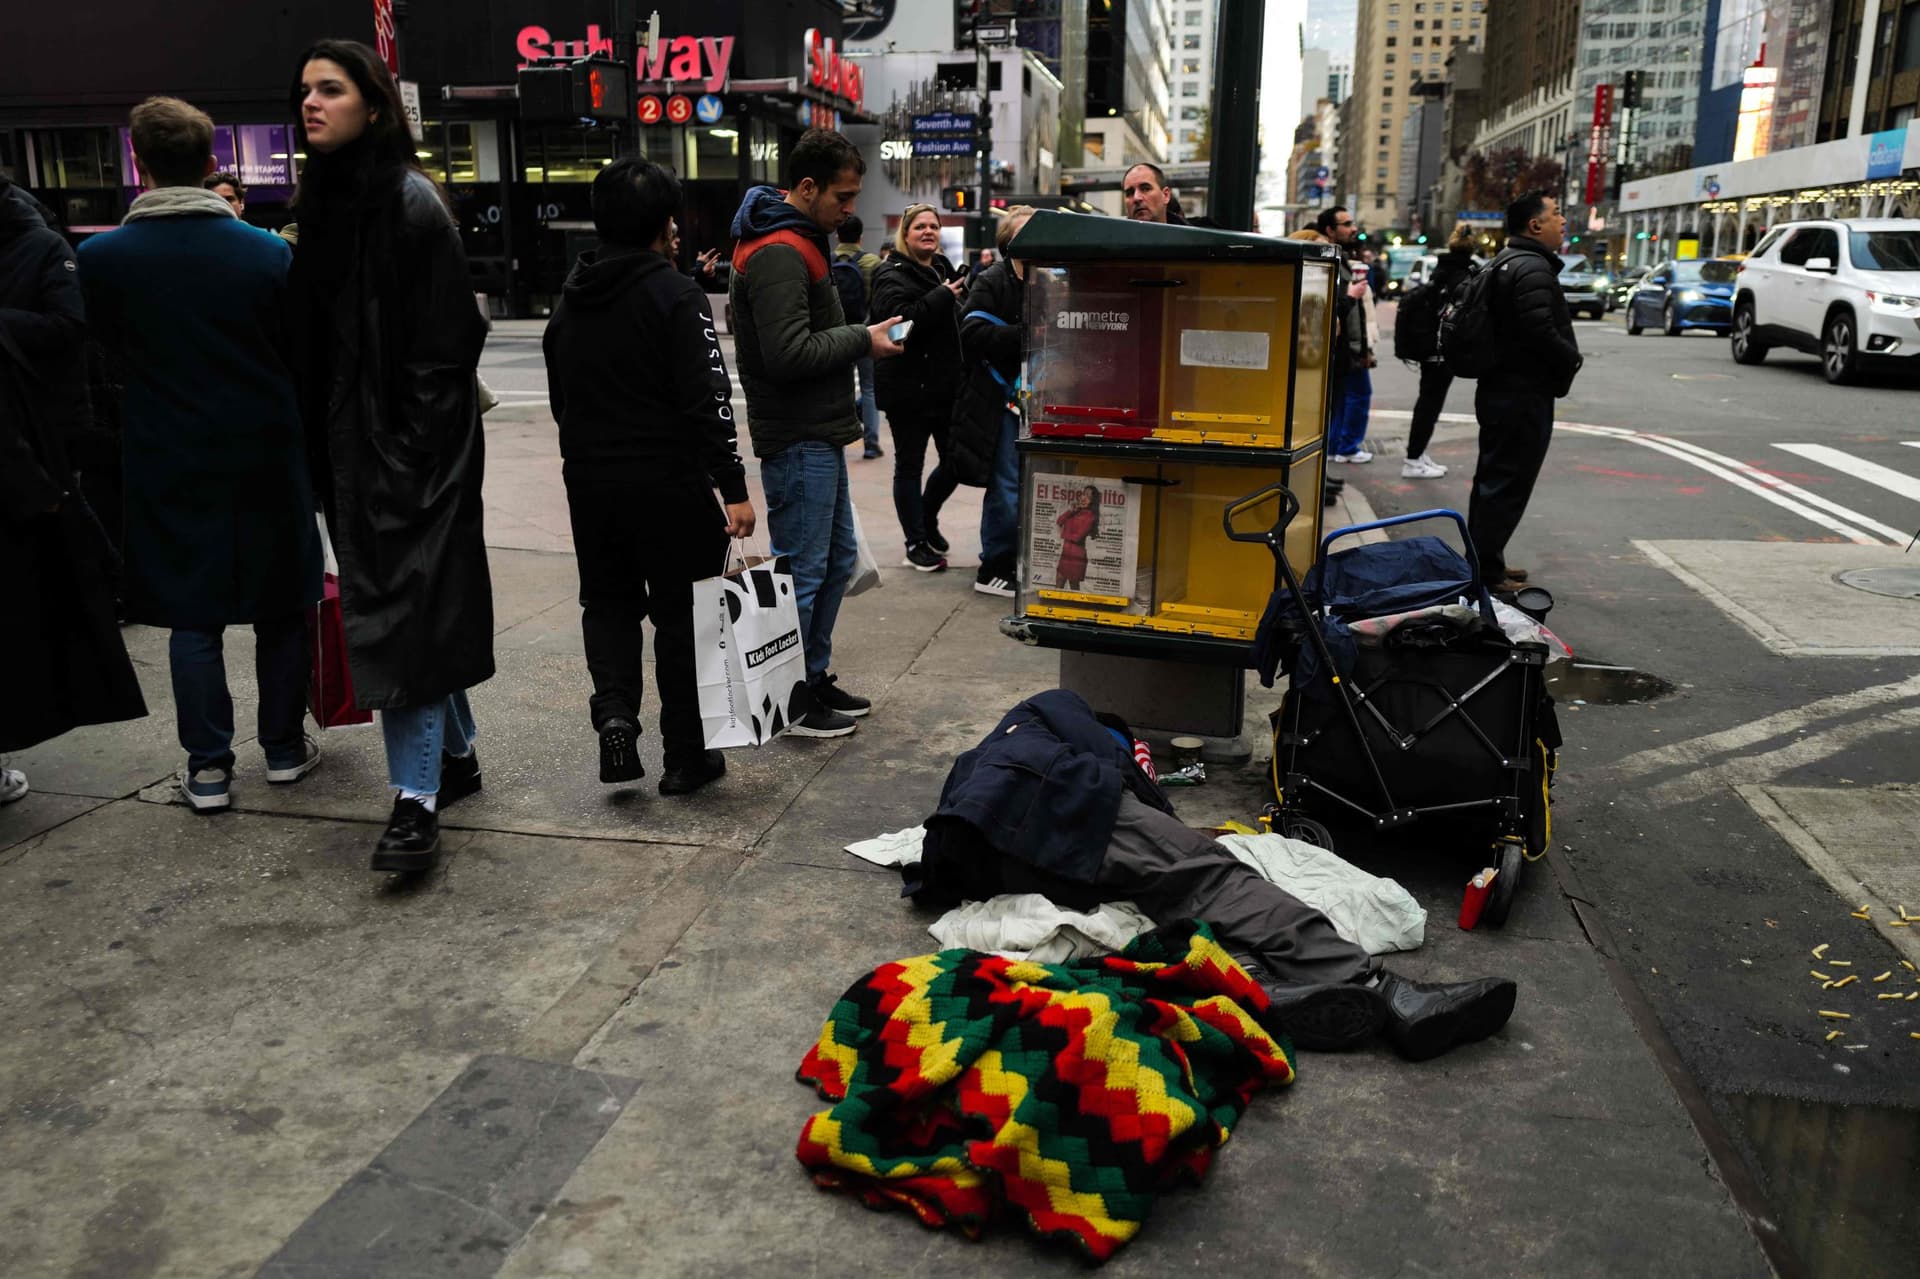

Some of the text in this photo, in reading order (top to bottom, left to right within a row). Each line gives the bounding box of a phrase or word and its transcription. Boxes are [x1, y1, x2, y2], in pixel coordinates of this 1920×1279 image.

[914, 118, 972, 130] Seventh Ave
[916, 142, 971, 153] Fashion Ave
[699, 312, 724, 375] JUST
[1037, 483, 1126, 506] El Espelito
[748, 633, 798, 665] Kids Foot Locker
